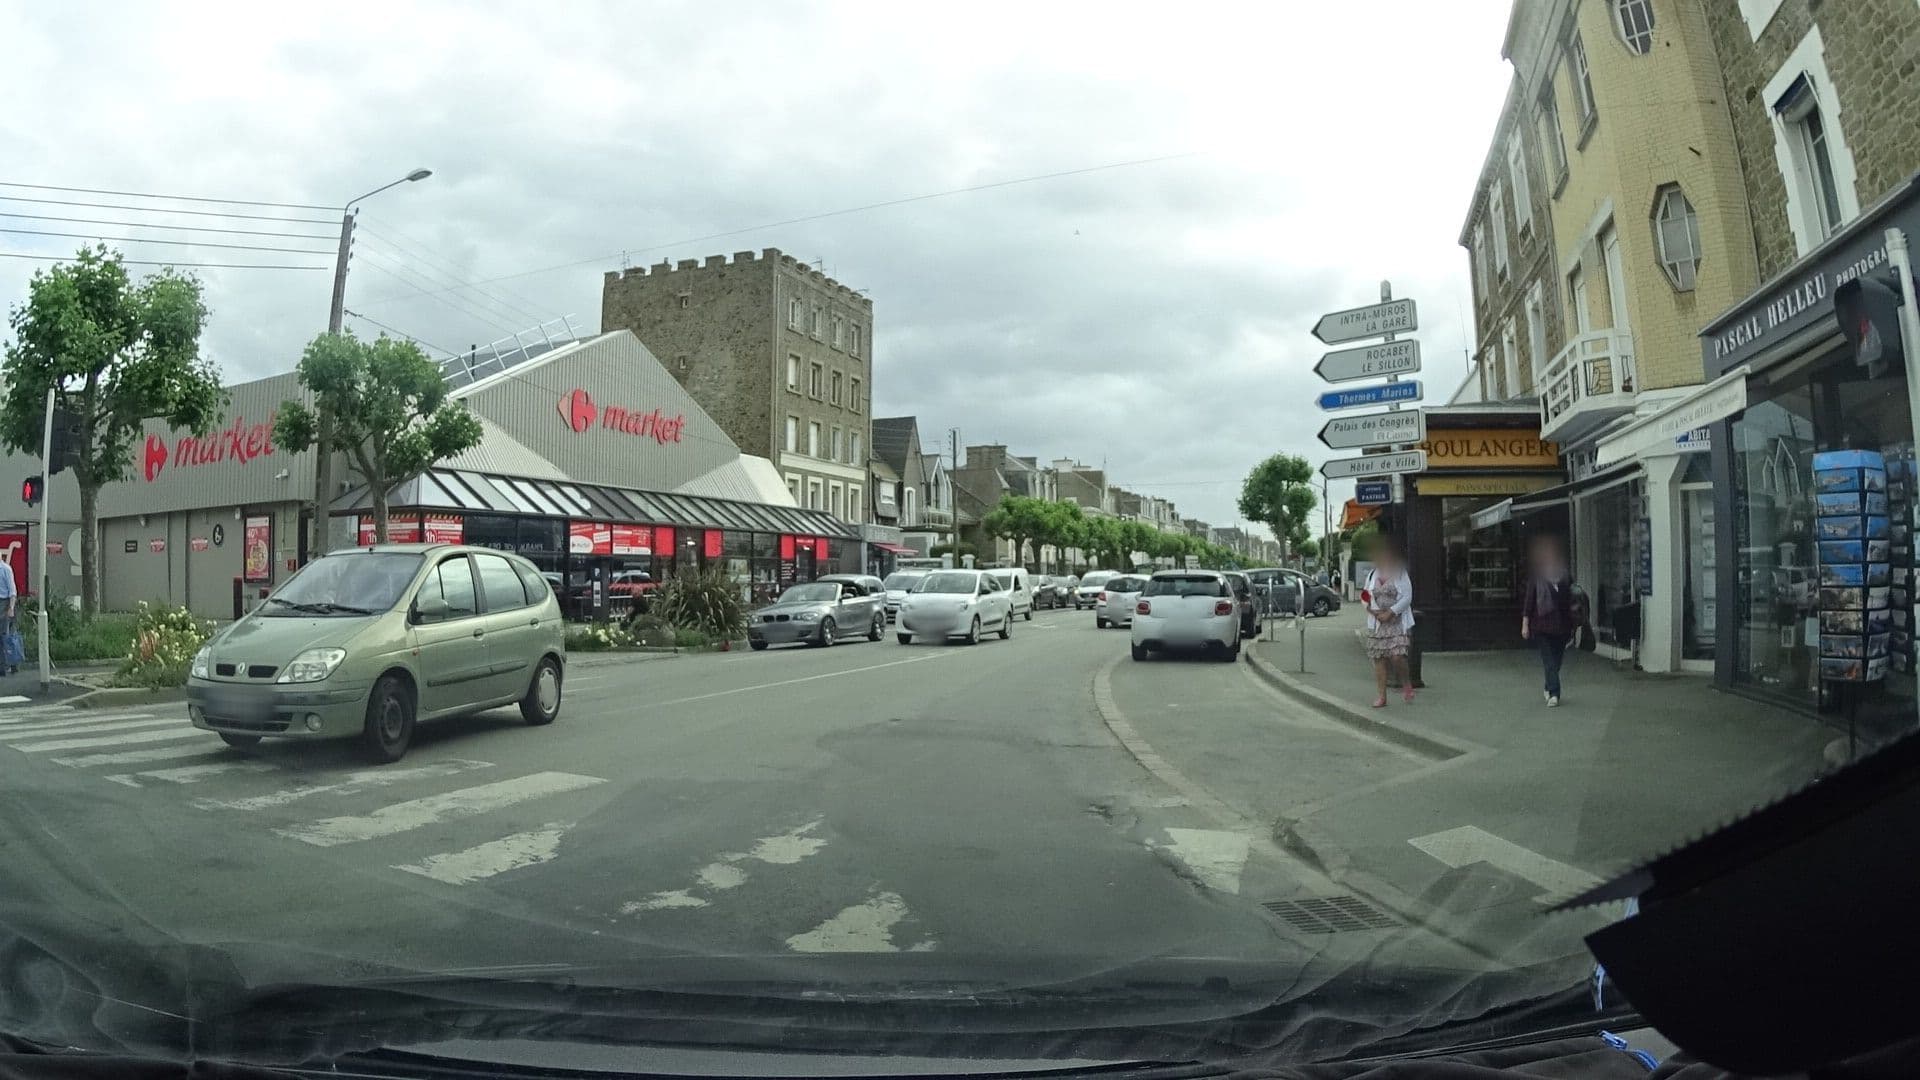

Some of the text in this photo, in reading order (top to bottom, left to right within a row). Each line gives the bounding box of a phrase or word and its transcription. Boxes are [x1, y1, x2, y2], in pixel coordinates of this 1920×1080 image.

[1340, 304, 1406, 326] INTRA-MUROS
[1714, 316, 1763, 360] PASCAL
[1767, 272, 1827, 328] HELLEU
[1366, 317, 1407, 332] LA GARE
[1367, 345, 1410, 360] ROCABEY
[1362, 357, 1411, 373] LE SILLON
[1339, 386, 1413, 405] Thermes Marins
[603, 405, 685, 446] market
[1334, 416, 1415, 433] Palais des Congrès
[174, 409, 276, 468] market
[1350, 457, 1416, 473] Hôtel de Ville
